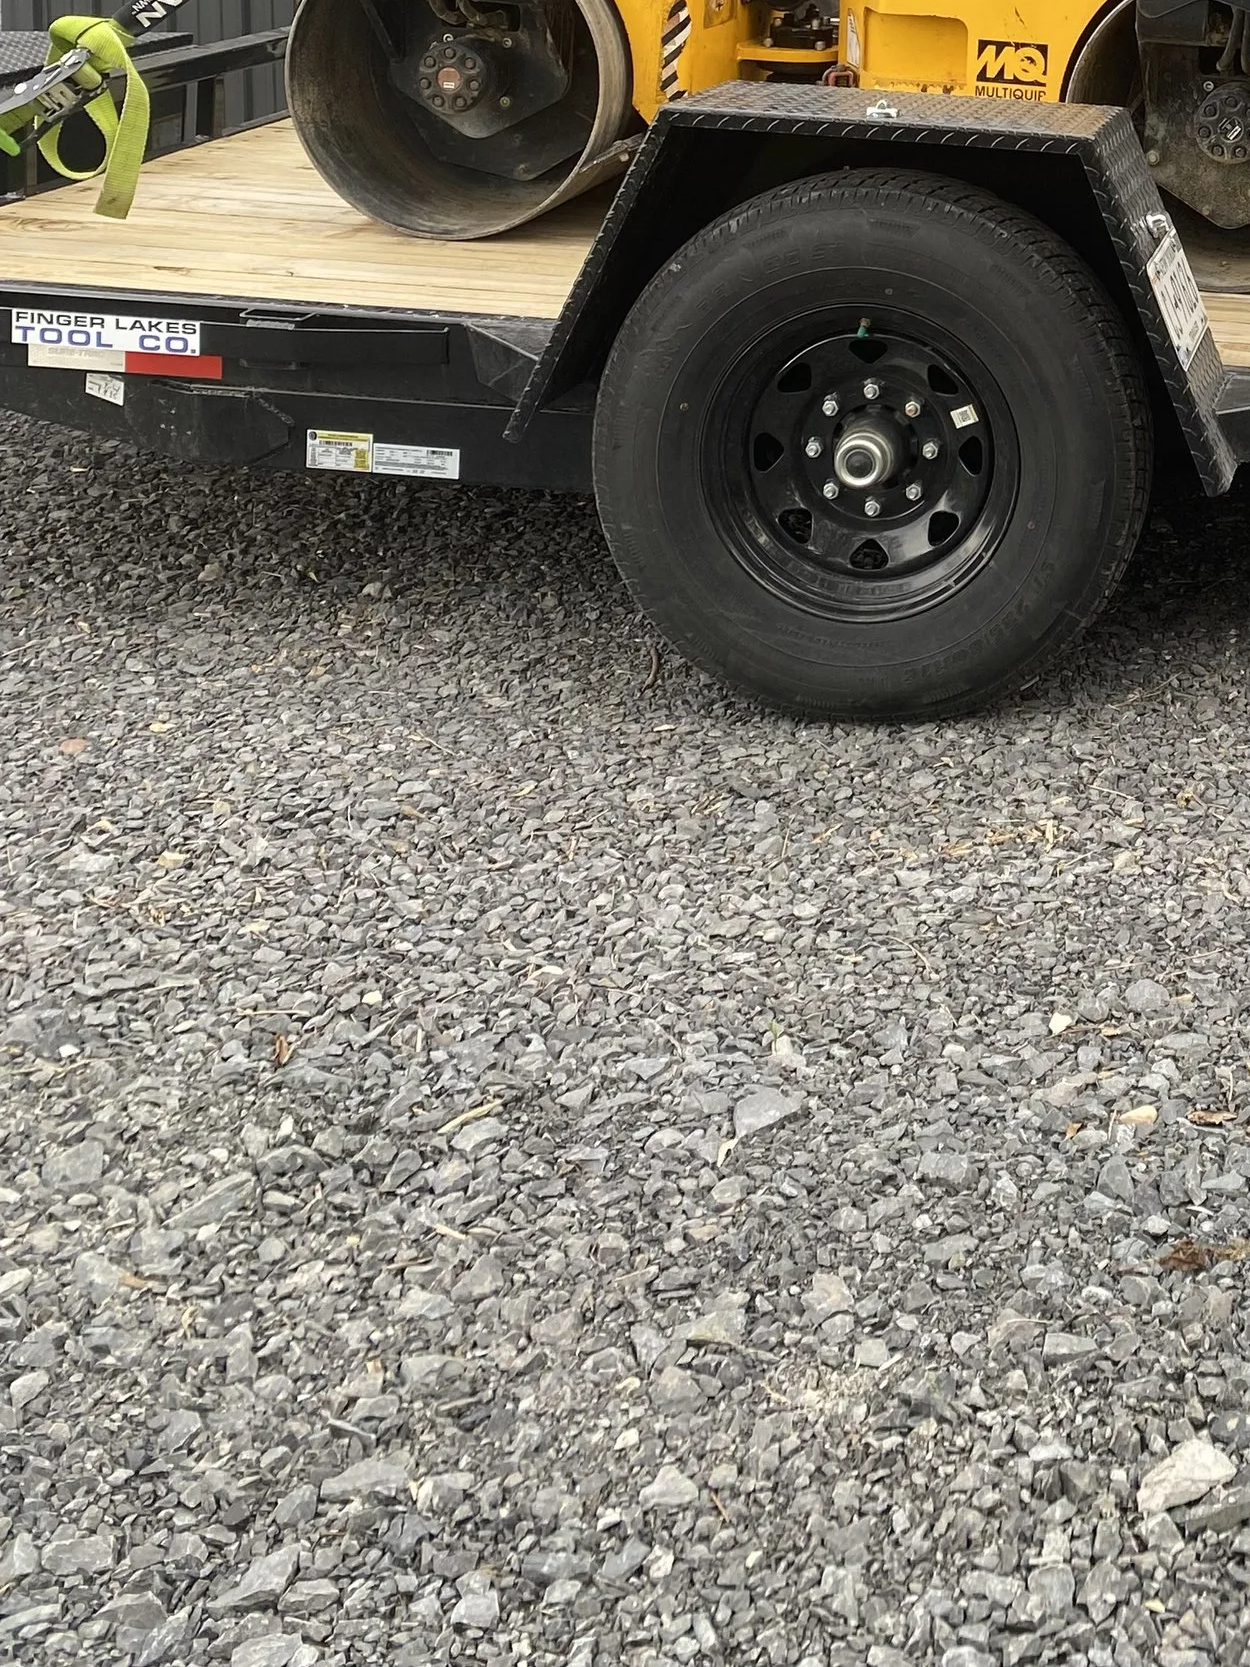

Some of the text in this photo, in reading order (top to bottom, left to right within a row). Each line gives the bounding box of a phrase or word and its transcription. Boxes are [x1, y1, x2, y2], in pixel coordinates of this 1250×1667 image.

[977, 44, 1047, 84] MQ
[15, 311, 197, 335] FINGER LAKES
[15, 326, 197, 354] TOOL CO.
